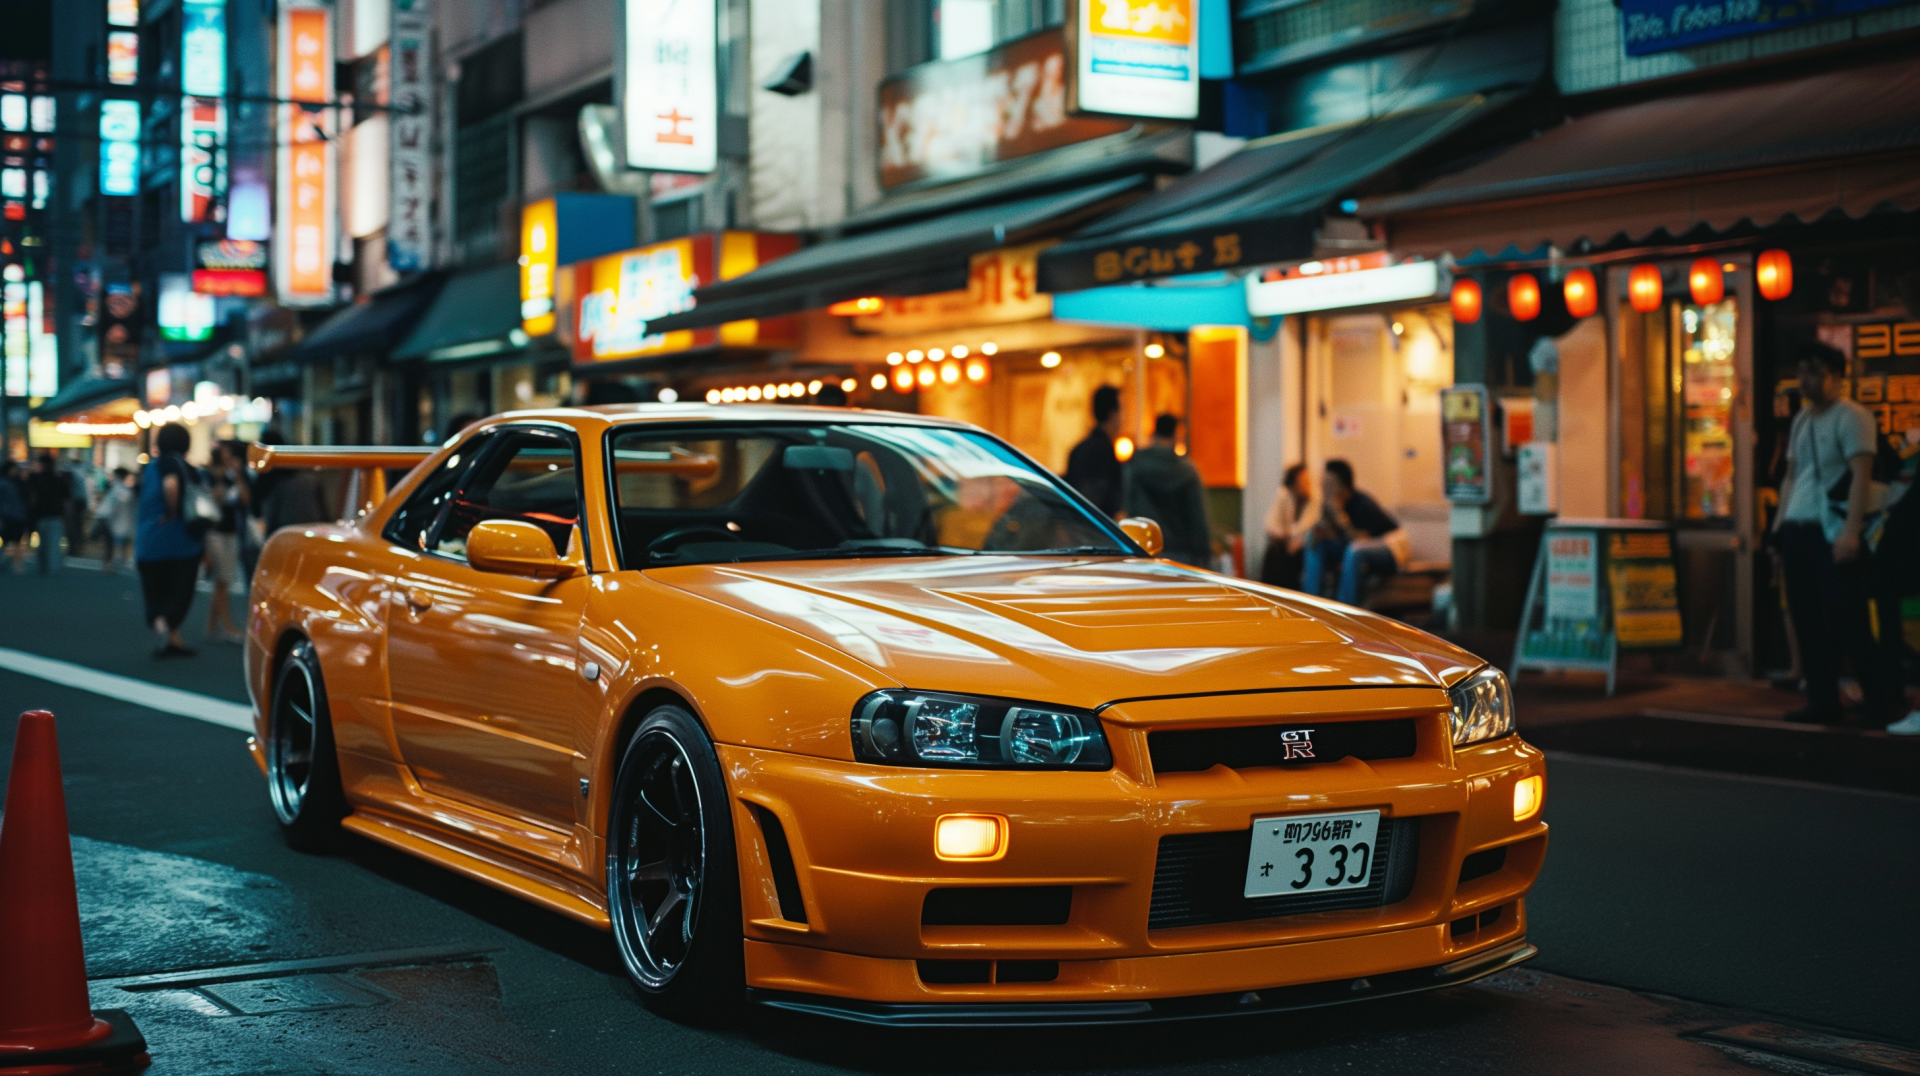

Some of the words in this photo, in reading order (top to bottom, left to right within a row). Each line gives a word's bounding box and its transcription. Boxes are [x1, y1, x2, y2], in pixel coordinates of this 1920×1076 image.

[1281, 729, 1315, 741] GT
[1282, 741, 1315, 760] R
[1290, 847, 1315, 889] 3
